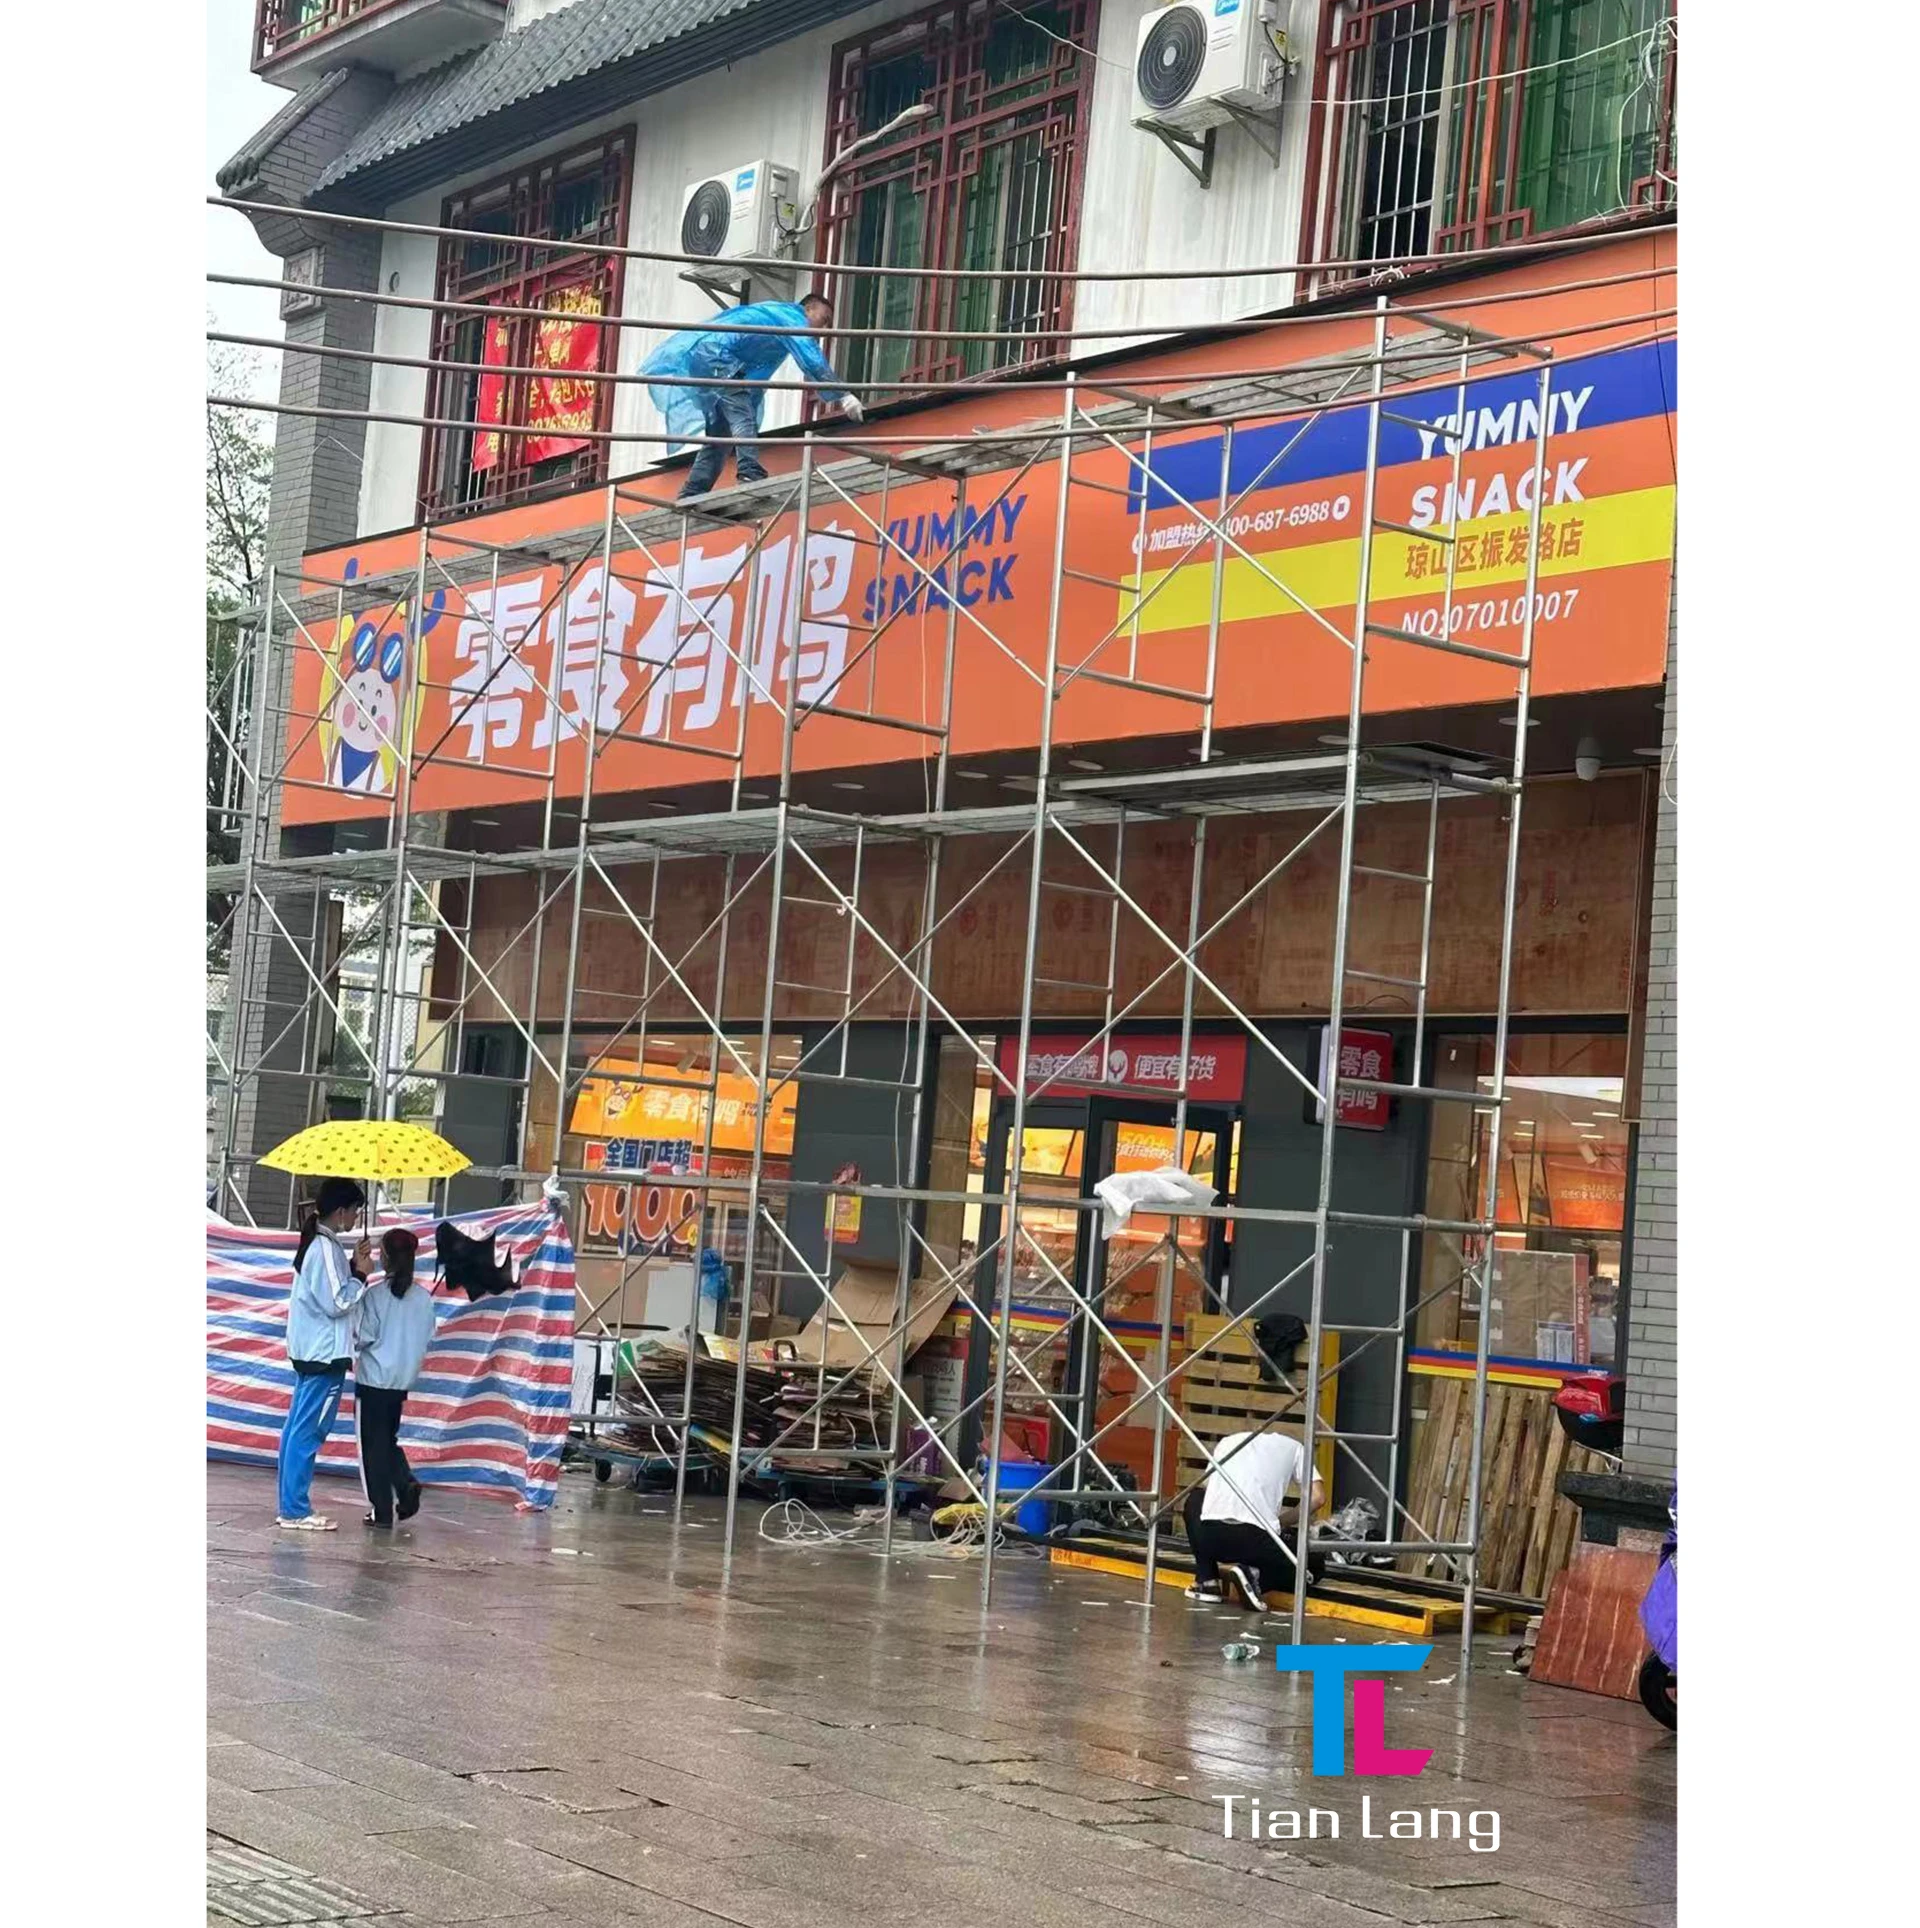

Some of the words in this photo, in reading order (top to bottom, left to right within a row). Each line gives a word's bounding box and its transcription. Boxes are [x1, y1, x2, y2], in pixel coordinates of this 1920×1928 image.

[1417, 385, 1595, 460] YUMMY
[1409, 456, 1588, 529] SNACK
[874, 494, 1028, 565] YUMMY
[1404, 517, 1585, 580] 琼山区振发路店
[862, 553, 1019, 622] SNACK
[449, 519, 857, 757] 零食有鸣
[1134, 1054, 1217, 1080] 便宜有好货
[1340, 1045, 1383, 1080] 零食
